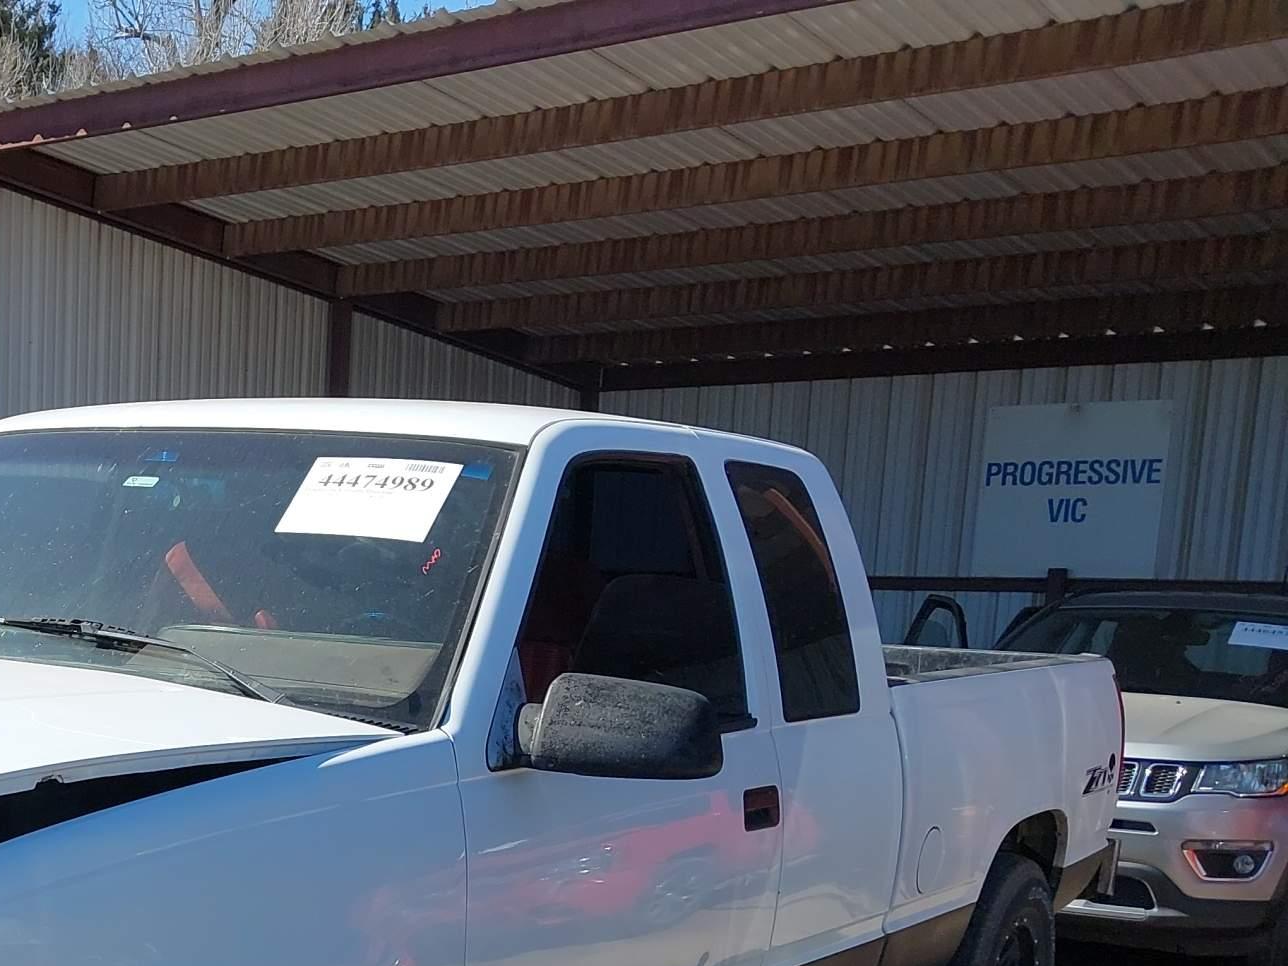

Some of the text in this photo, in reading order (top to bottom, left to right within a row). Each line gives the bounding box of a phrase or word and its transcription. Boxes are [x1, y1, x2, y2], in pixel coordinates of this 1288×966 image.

[318, 473, 435, 492] 44474989
[985, 458, 1163, 487] PROGRESSIVE
[1048, 498, 1088, 523] VIC
